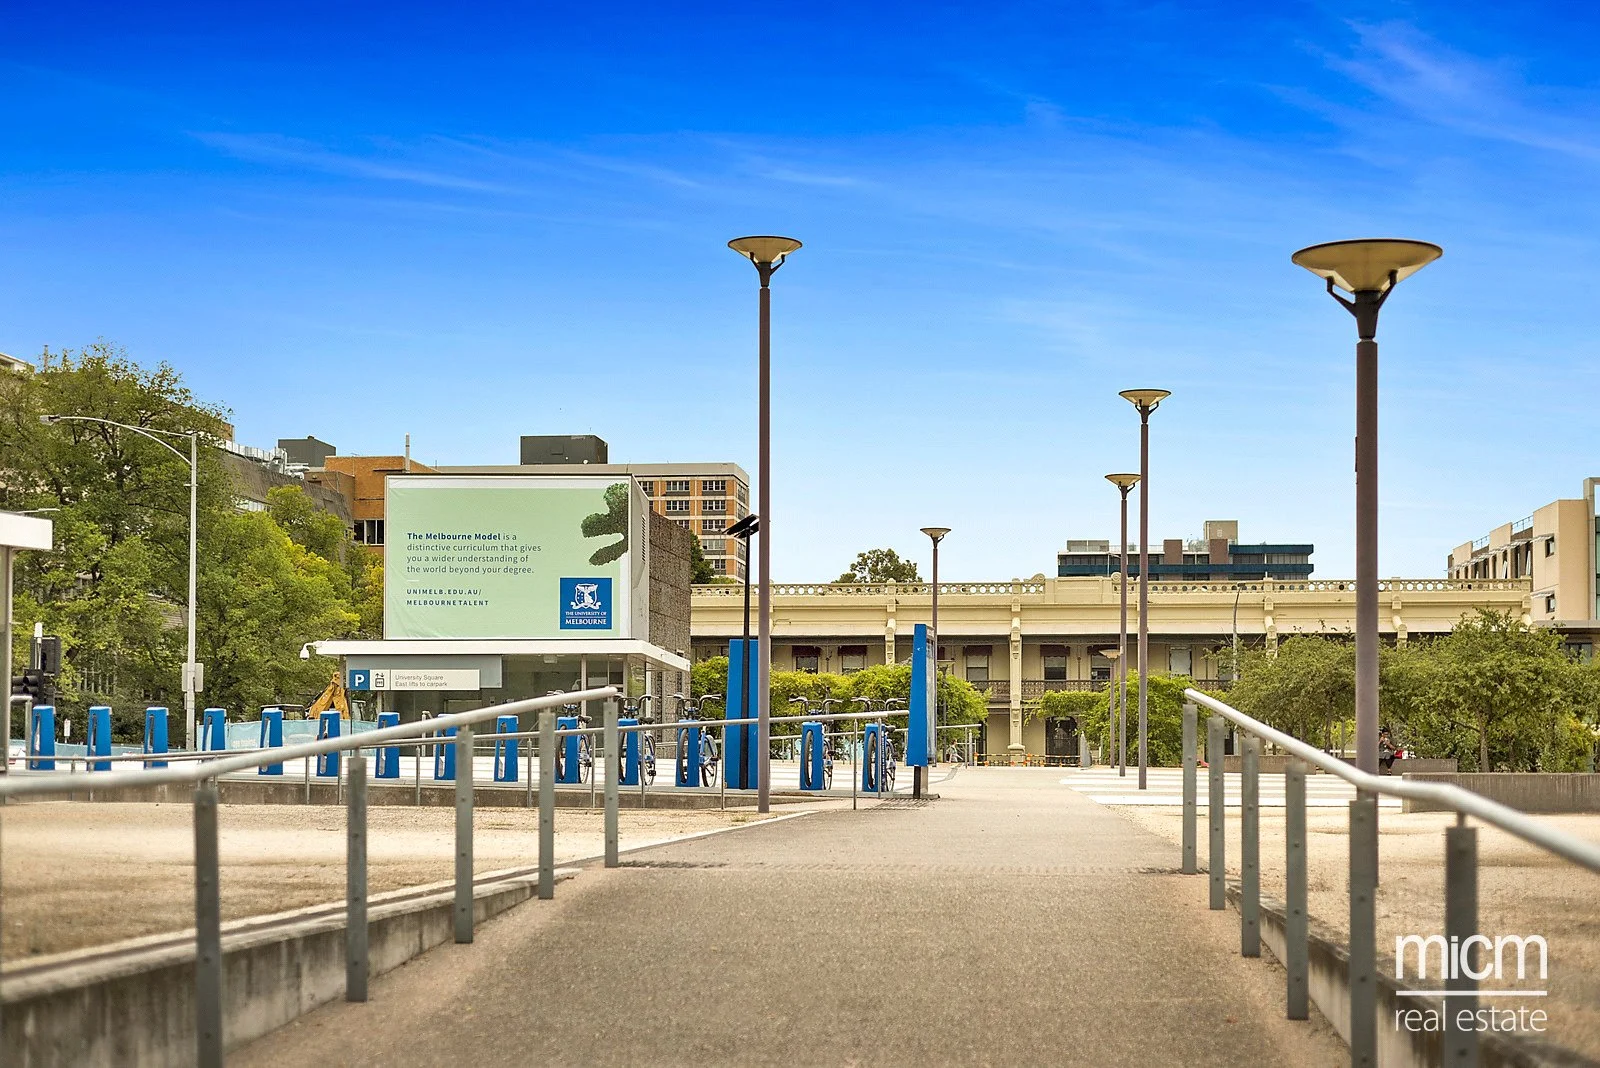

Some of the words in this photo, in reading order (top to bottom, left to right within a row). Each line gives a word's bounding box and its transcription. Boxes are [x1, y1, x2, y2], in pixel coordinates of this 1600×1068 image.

[520, 544, 542, 553] gives
[457, 554, 518, 564] understanding
[449, 566, 479, 575] beyond
[482, 567, 501, 575] your
[503, 566, 534, 575] degree.
[354, 674, 364, 686] P
